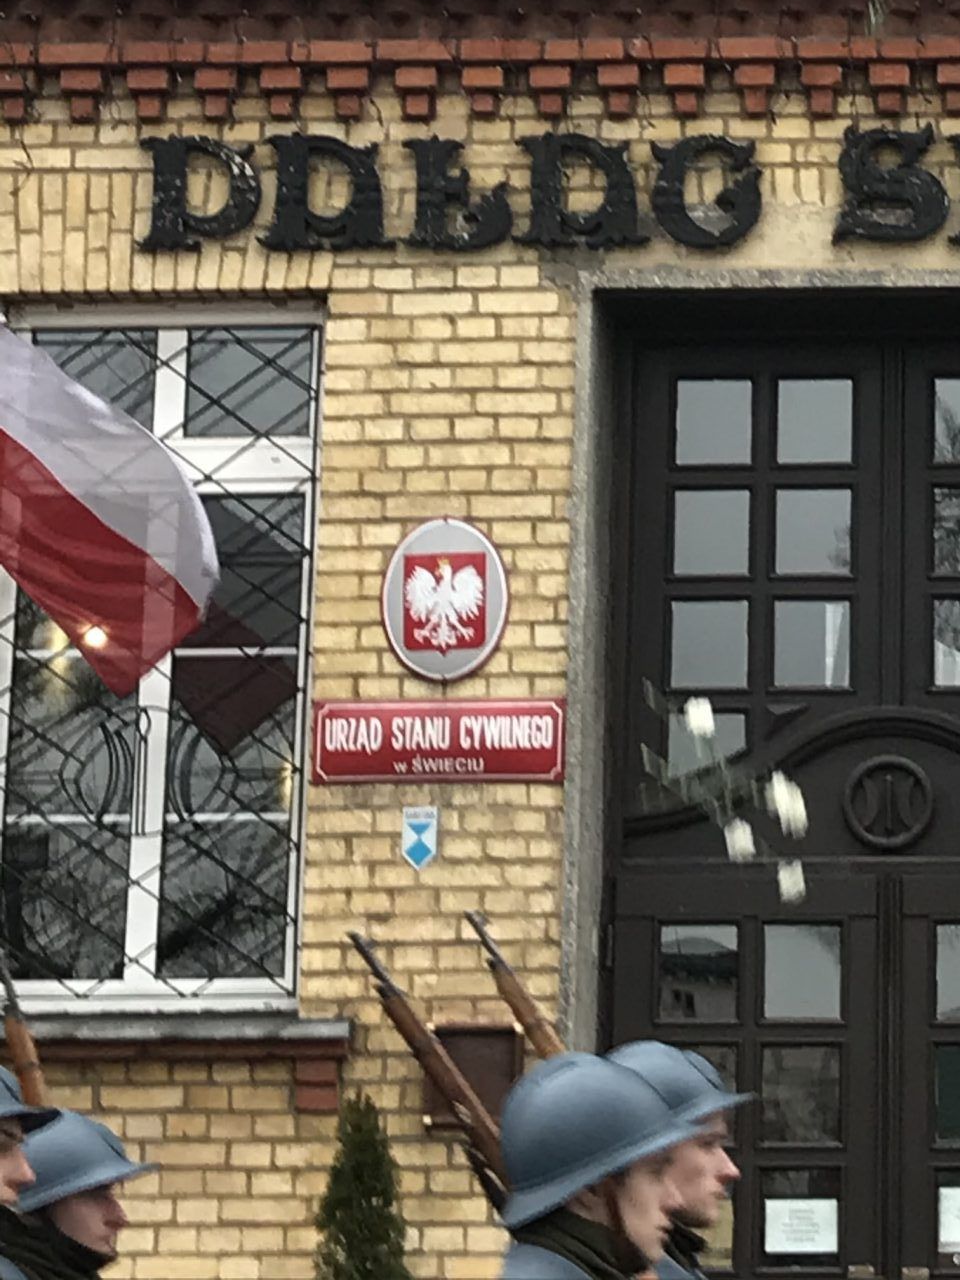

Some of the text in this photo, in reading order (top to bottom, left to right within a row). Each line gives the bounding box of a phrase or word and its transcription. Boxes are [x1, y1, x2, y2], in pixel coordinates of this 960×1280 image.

[324, 714, 554, 755] URZĄD STANU CYWILNEGO
[412, 754, 485, 773] ŚWIECIU
